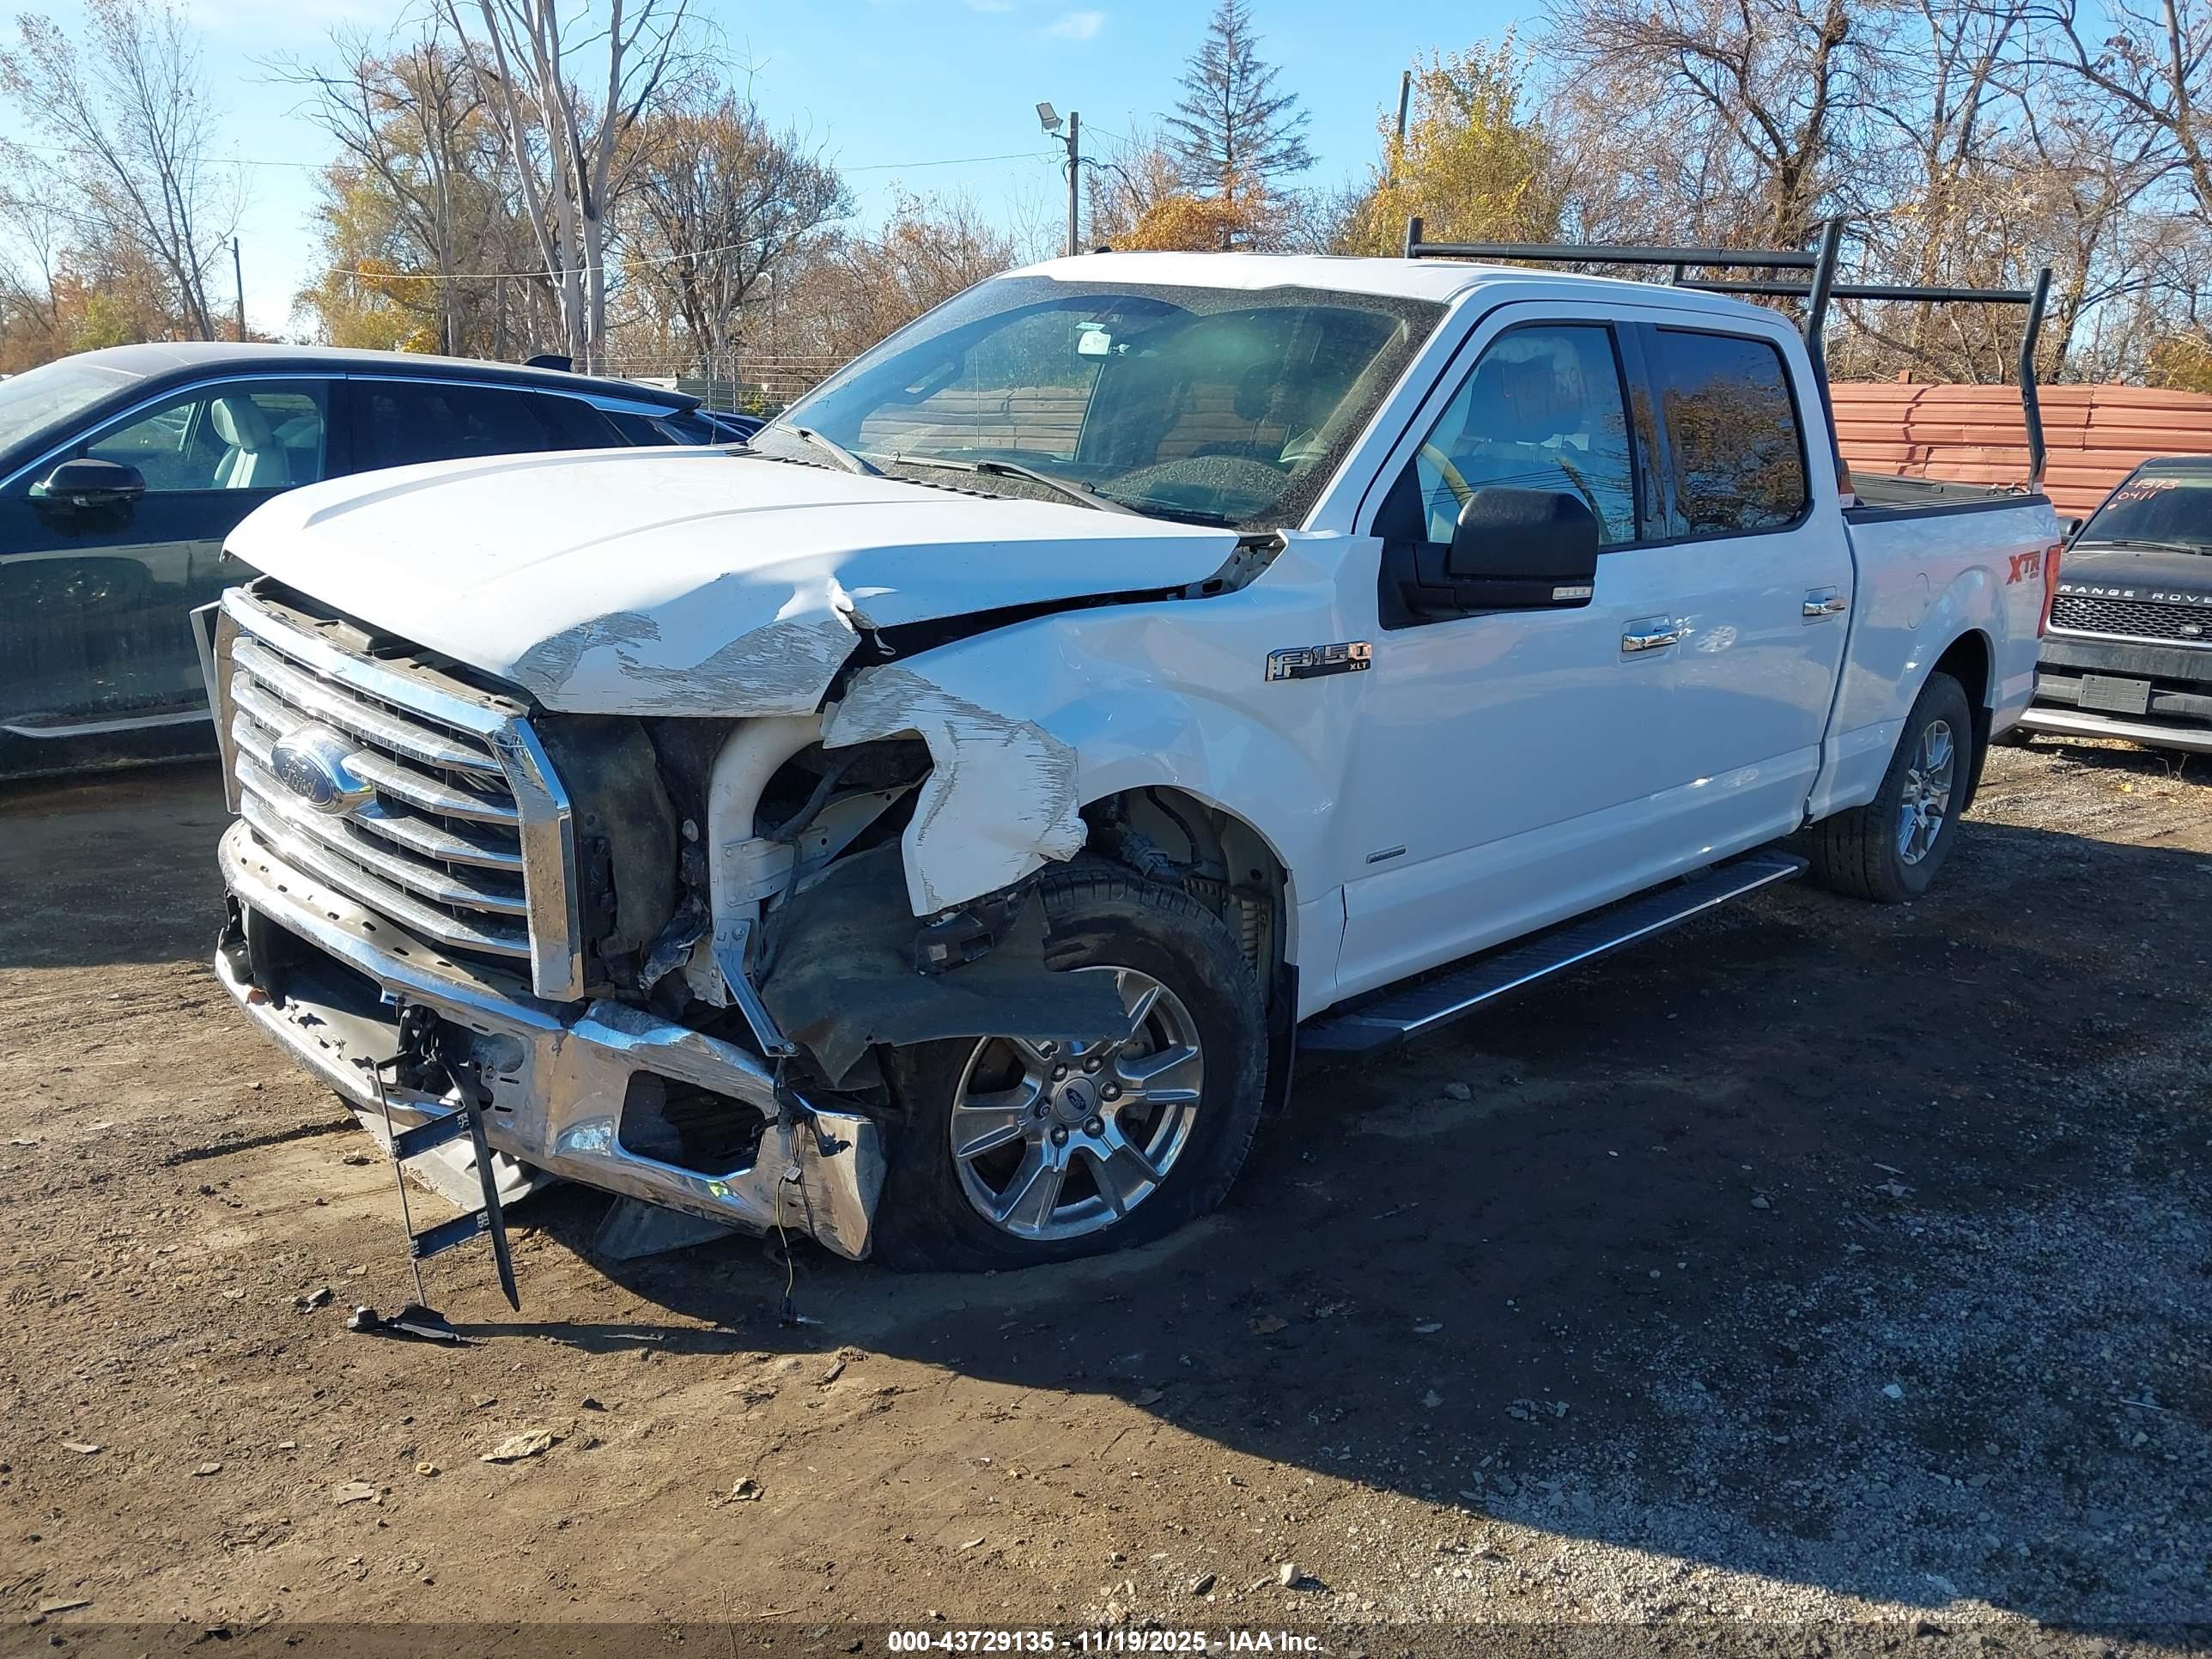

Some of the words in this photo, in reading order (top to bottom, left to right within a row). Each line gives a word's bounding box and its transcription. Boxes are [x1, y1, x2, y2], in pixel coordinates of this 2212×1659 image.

[2118, 490, 2157, 501] 0411
[2006, 550, 2040, 585] XTR
[2060, 585, 2136, 598] RANGE
[1349, 661, 1368, 671] XLT
[281, 755, 318, 800] Ford
